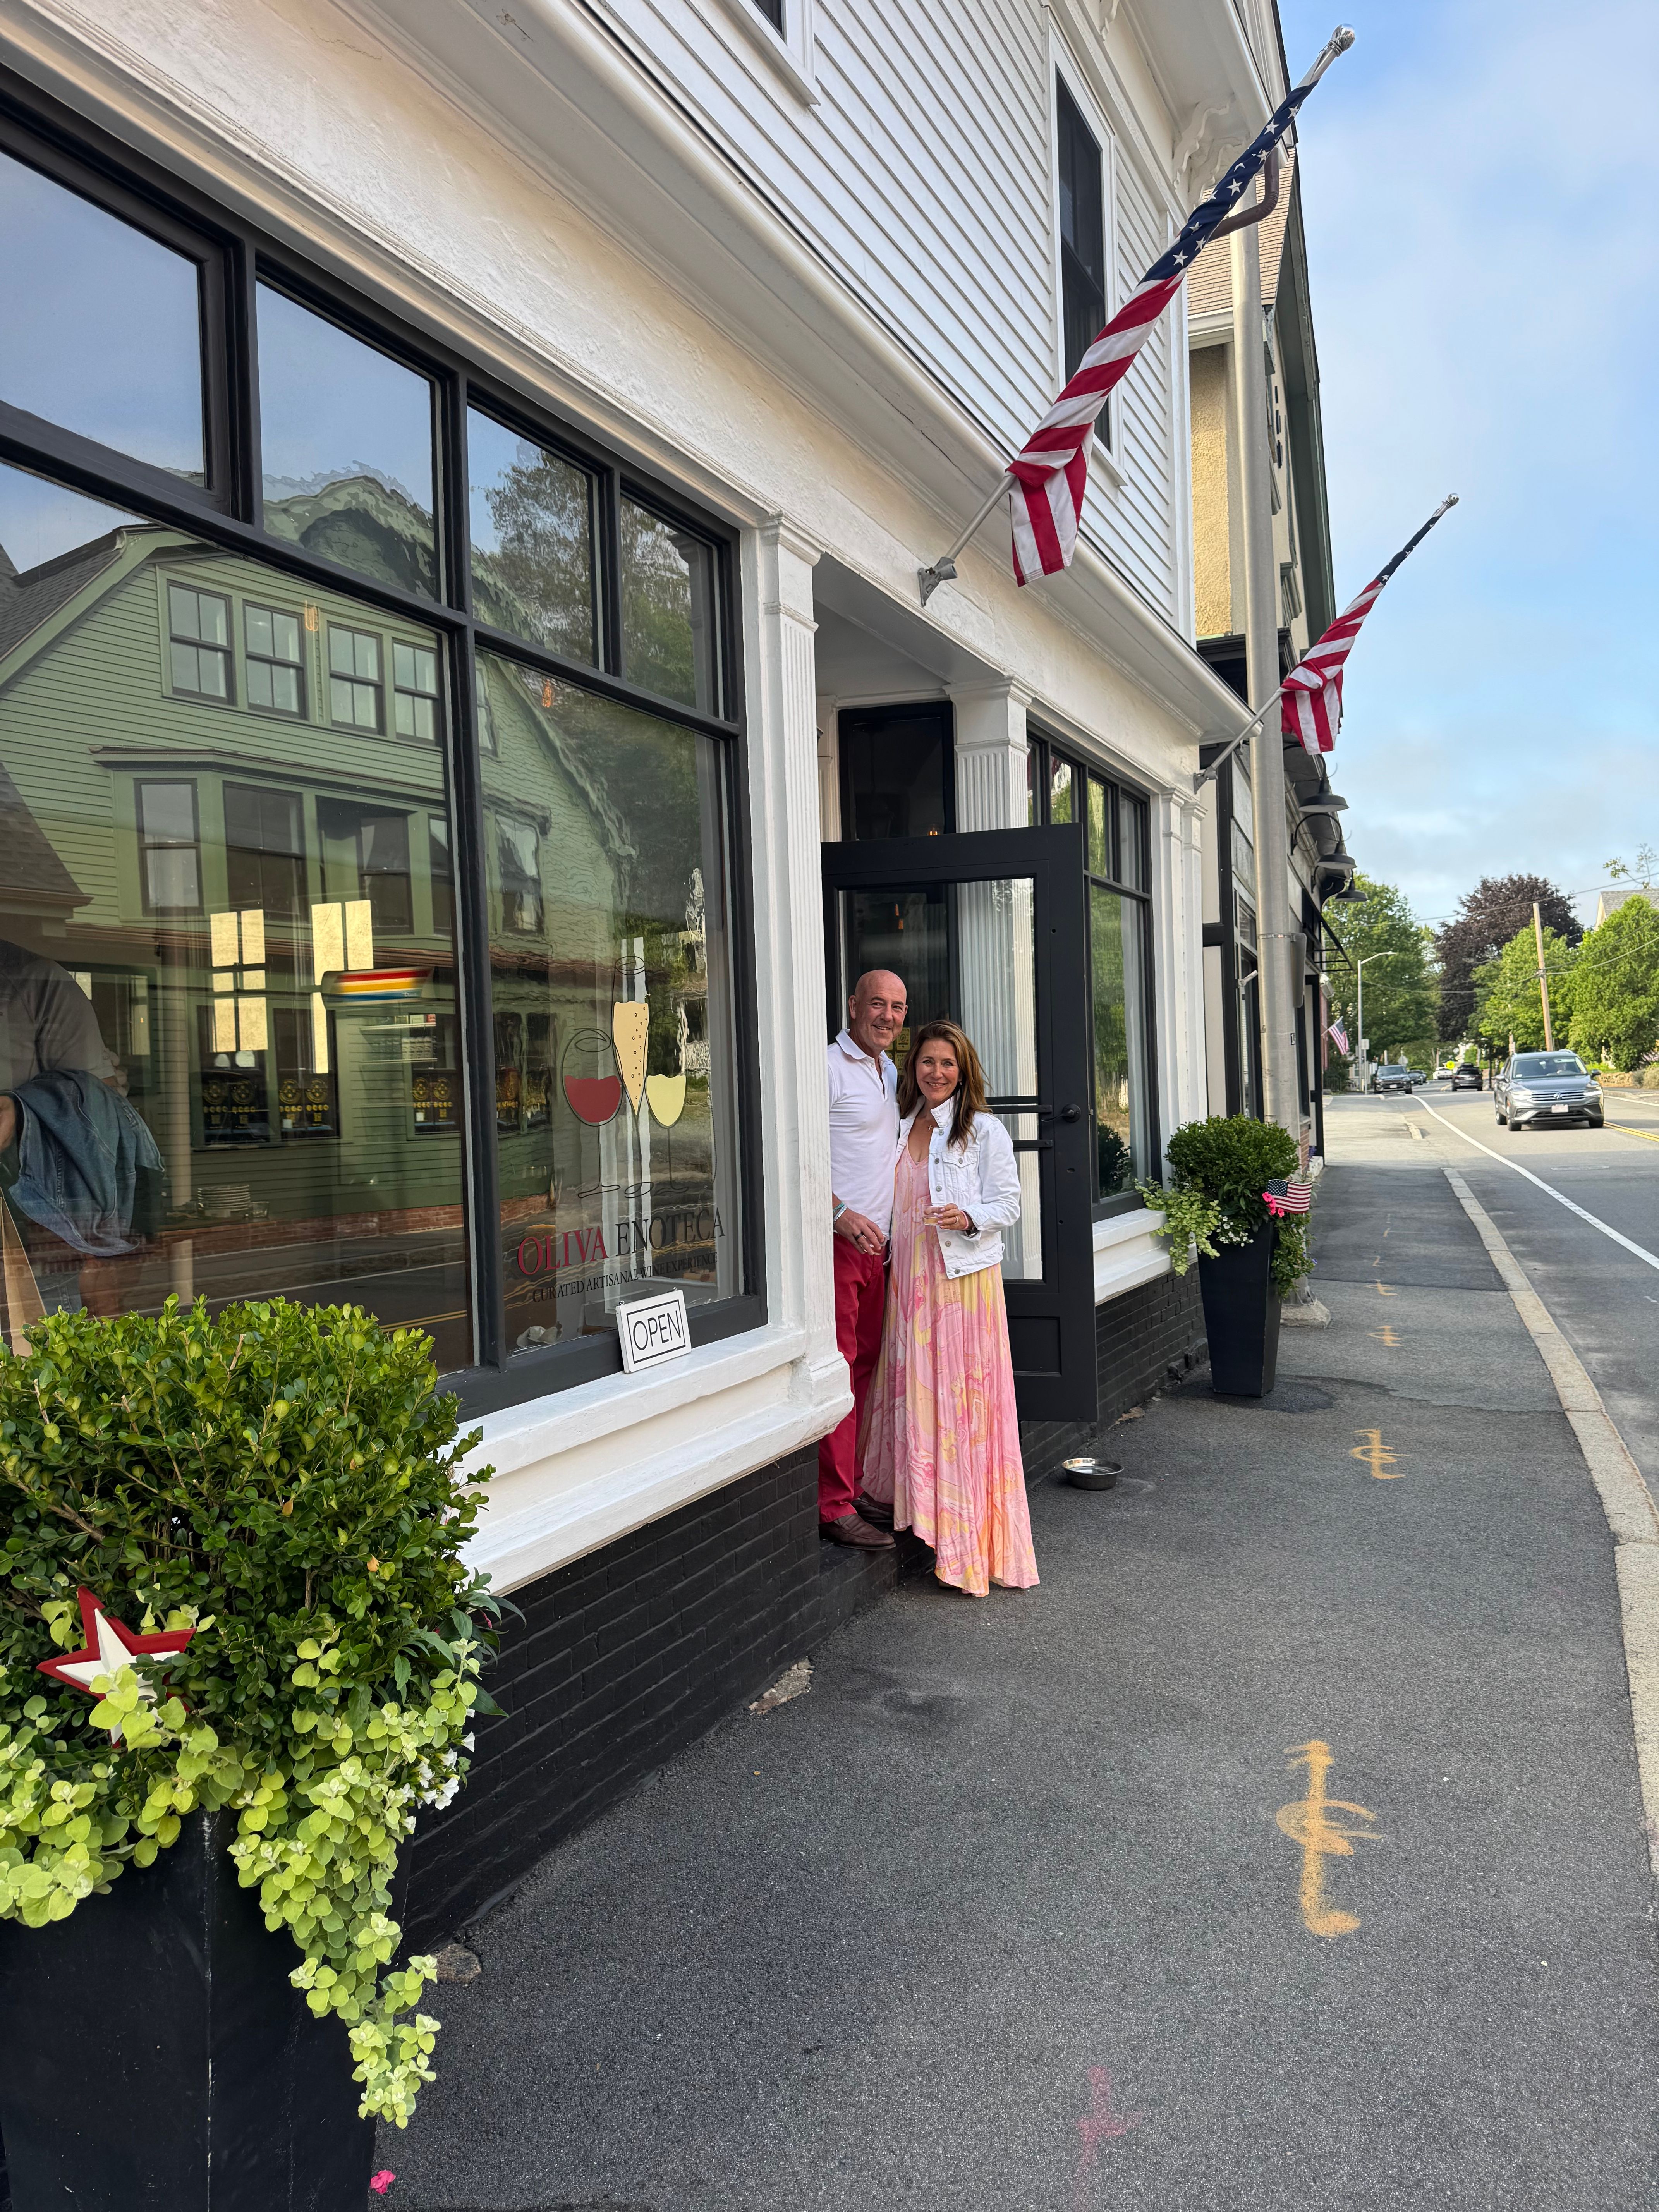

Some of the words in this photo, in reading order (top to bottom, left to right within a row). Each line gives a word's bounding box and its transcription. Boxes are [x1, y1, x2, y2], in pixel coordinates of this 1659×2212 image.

[518, 1226, 609, 1275] OLIVA
[615, 1207, 725, 1256] ENOTECA
[532, 1280, 584, 1303] CURATED
[586, 1268, 639, 1292] ARTISANAL
[640, 1263, 666, 1279] WINE
[666, 1252, 718, 1273] EXPERIENCE
[632, 1310, 682, 1351] OPEN
